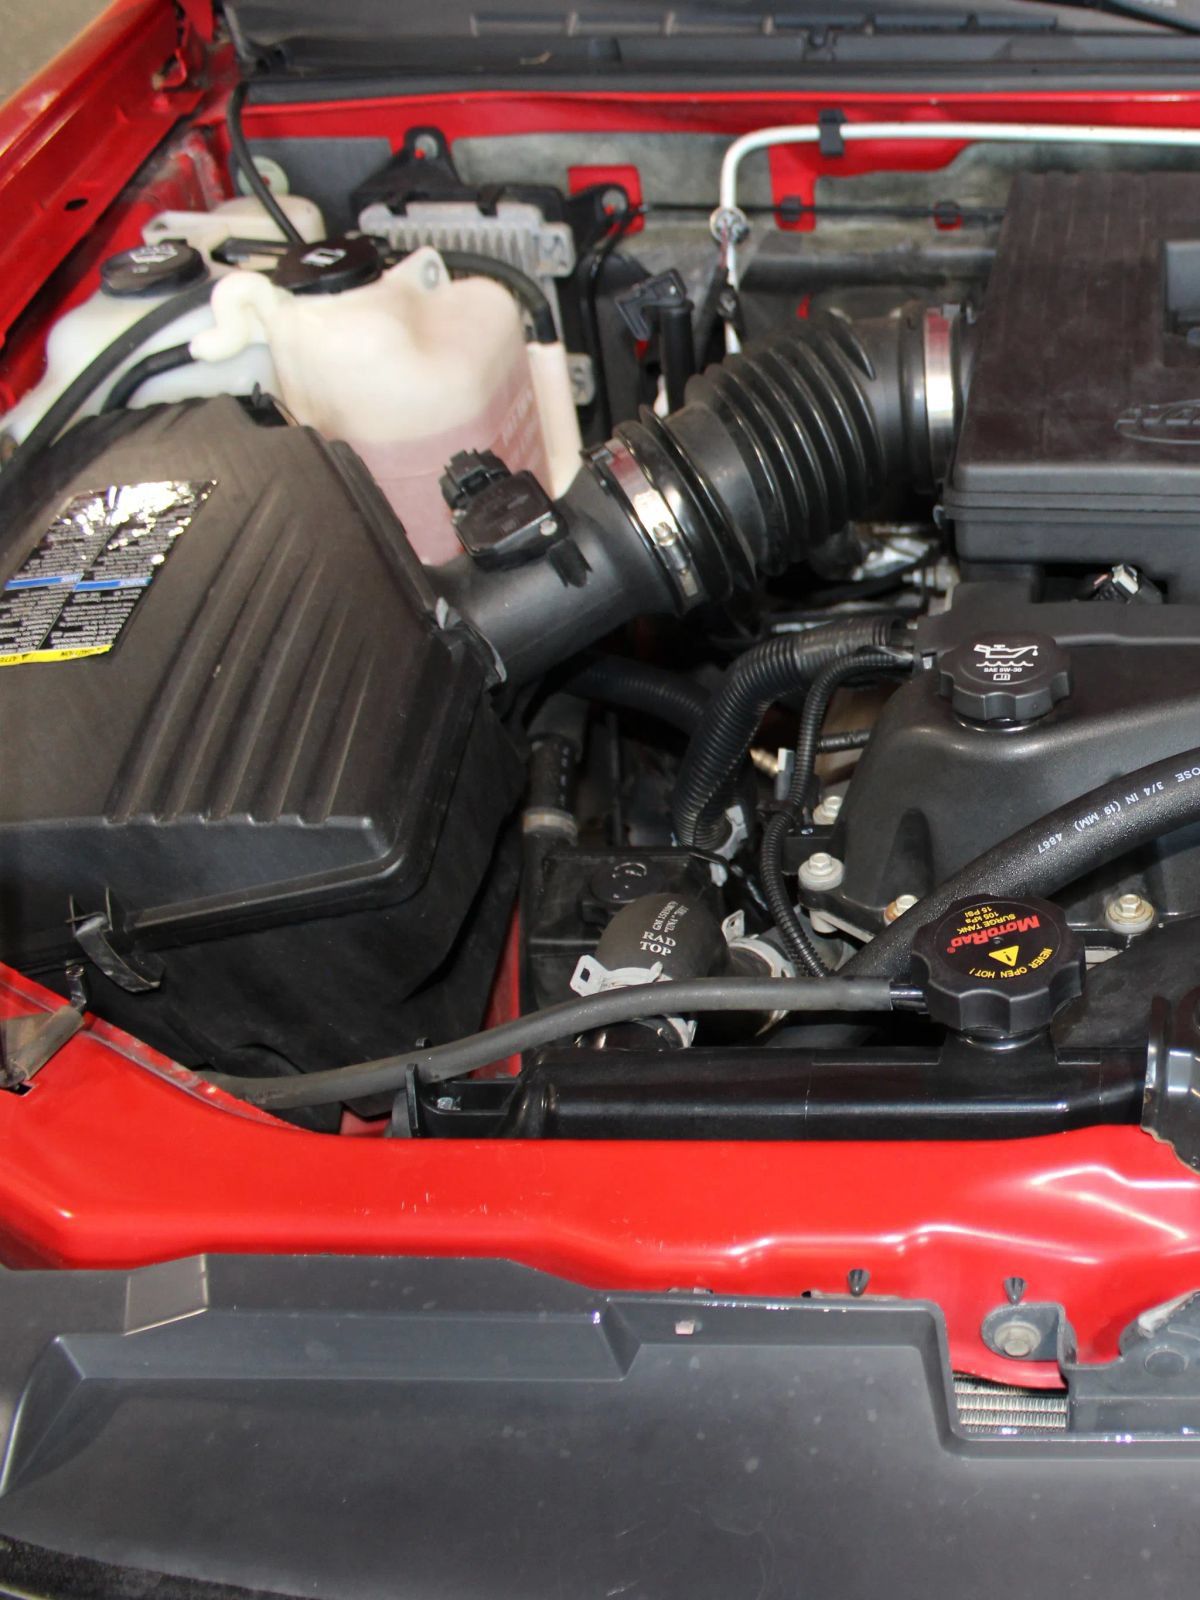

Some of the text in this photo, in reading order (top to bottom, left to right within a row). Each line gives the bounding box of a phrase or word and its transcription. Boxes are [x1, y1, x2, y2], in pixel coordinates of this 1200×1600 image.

[1143, 781, 1164, 797] 3/4
[1124, 792, 1140, 805] IN
[1104, 801, 1122, 816] (19
[1074, 812, 1100, 832] MM)
[964, 910, 981, 918] PSI
[956, 913, 1016, 934] SURGE TANK
[642, 931, 677, 947] RAD
[640, 941, 672, 956] TOP
[1028, 947, 1053, 969] NEVER
[1000, 966, 1028, 978] OPEN
